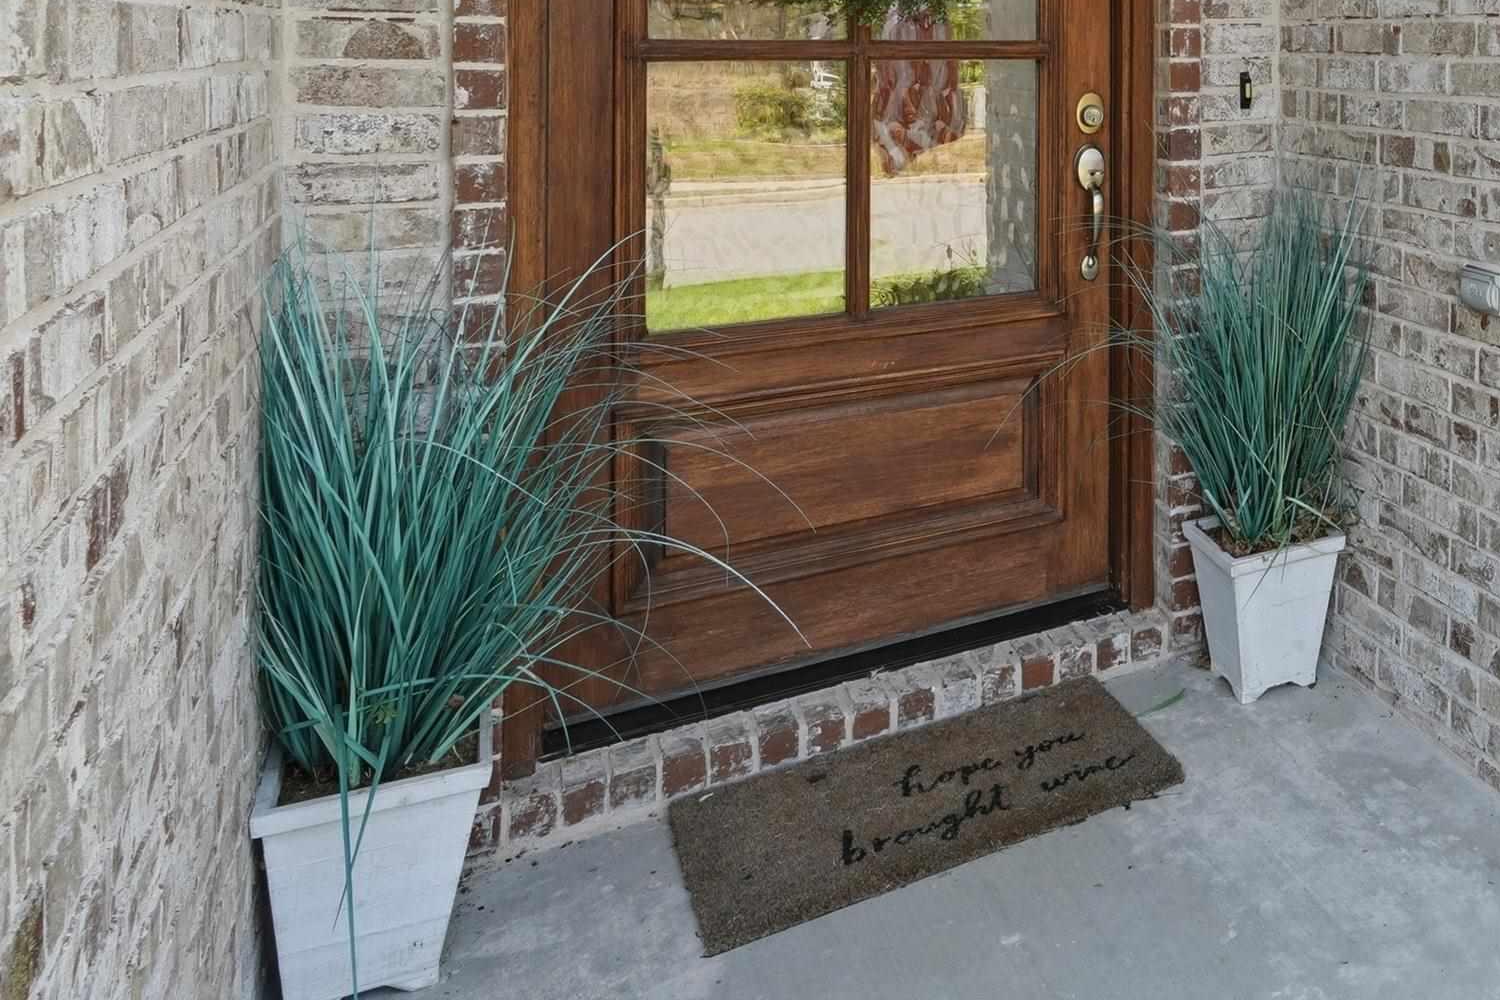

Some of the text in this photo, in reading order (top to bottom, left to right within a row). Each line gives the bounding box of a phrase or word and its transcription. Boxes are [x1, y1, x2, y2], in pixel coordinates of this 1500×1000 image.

[841, 752, 1136, 865] brought wine
[894, 732, 1086, 797] hope you
